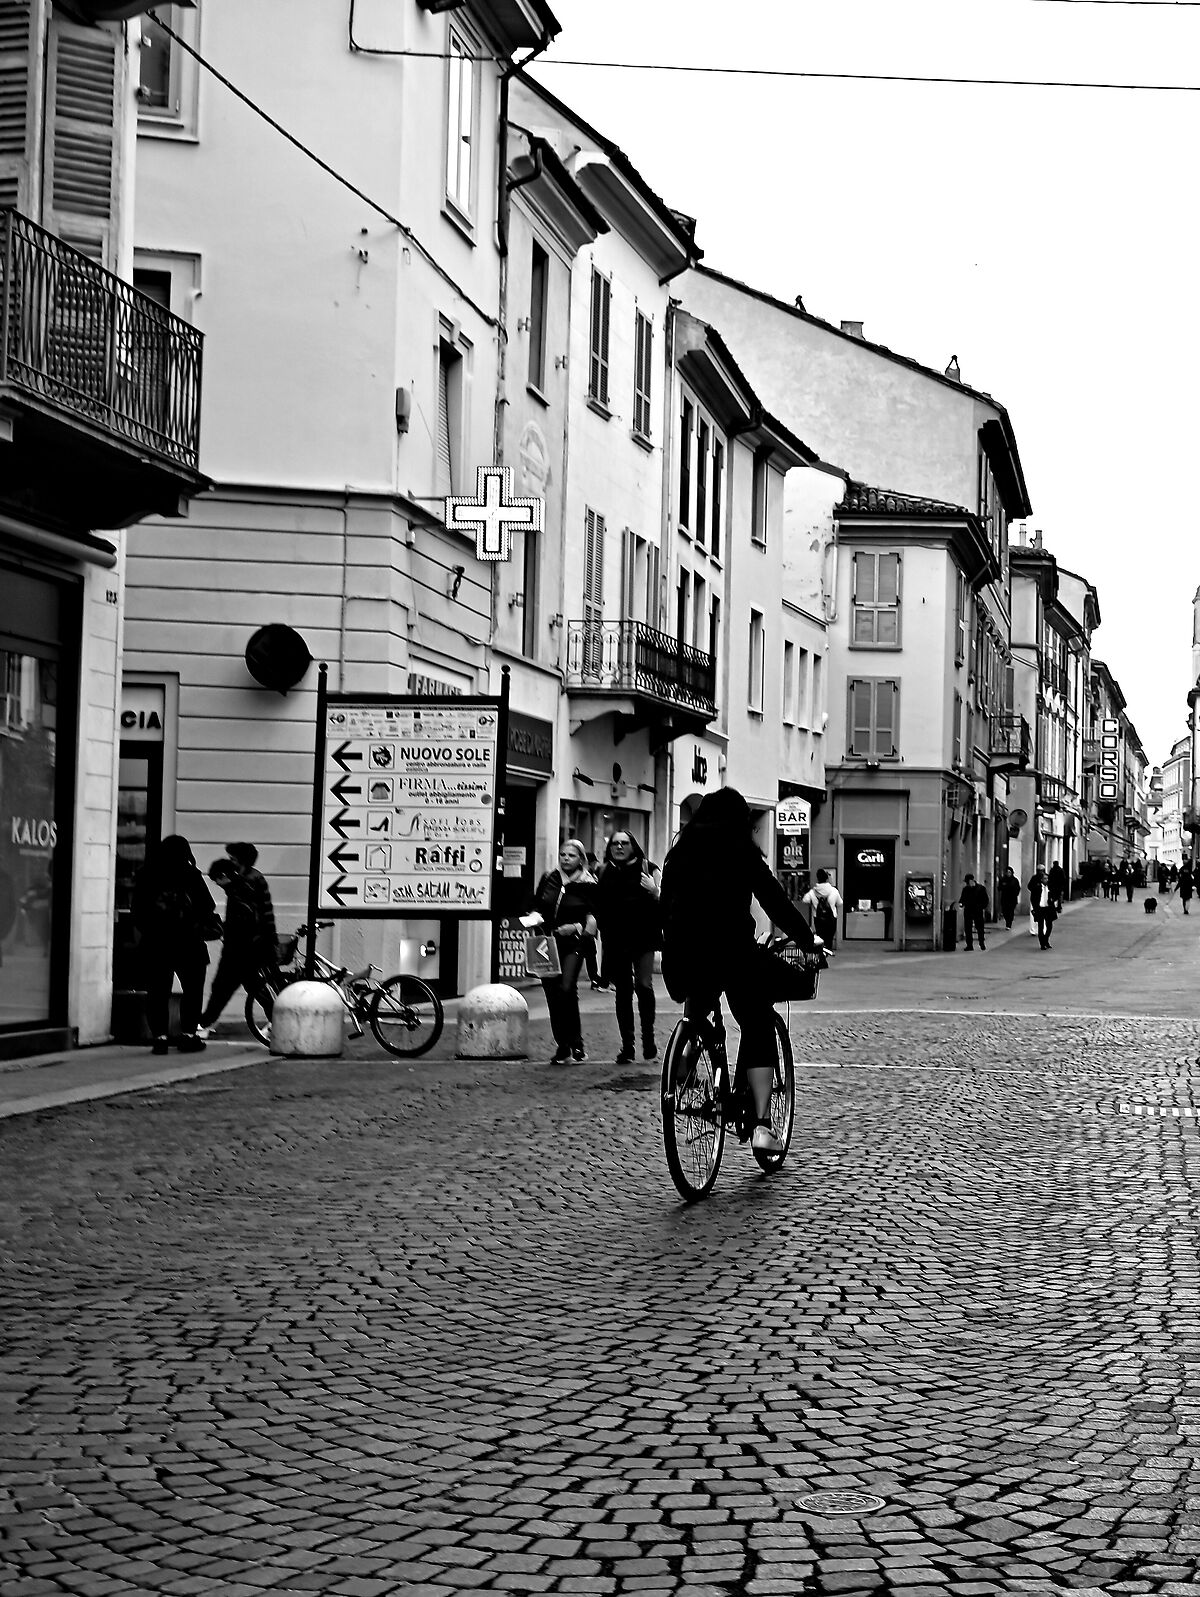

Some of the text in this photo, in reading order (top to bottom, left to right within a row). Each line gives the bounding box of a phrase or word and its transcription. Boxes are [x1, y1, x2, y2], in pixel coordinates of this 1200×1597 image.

[400, 747, 491, 761] NUOVO SOLE
[1100, 718, 1118, 798] CORSO
[778, 812, 807, 822] BAR
[11, 816, 57, 848] KALOS
[415, 845, 466, 866] Raffi
